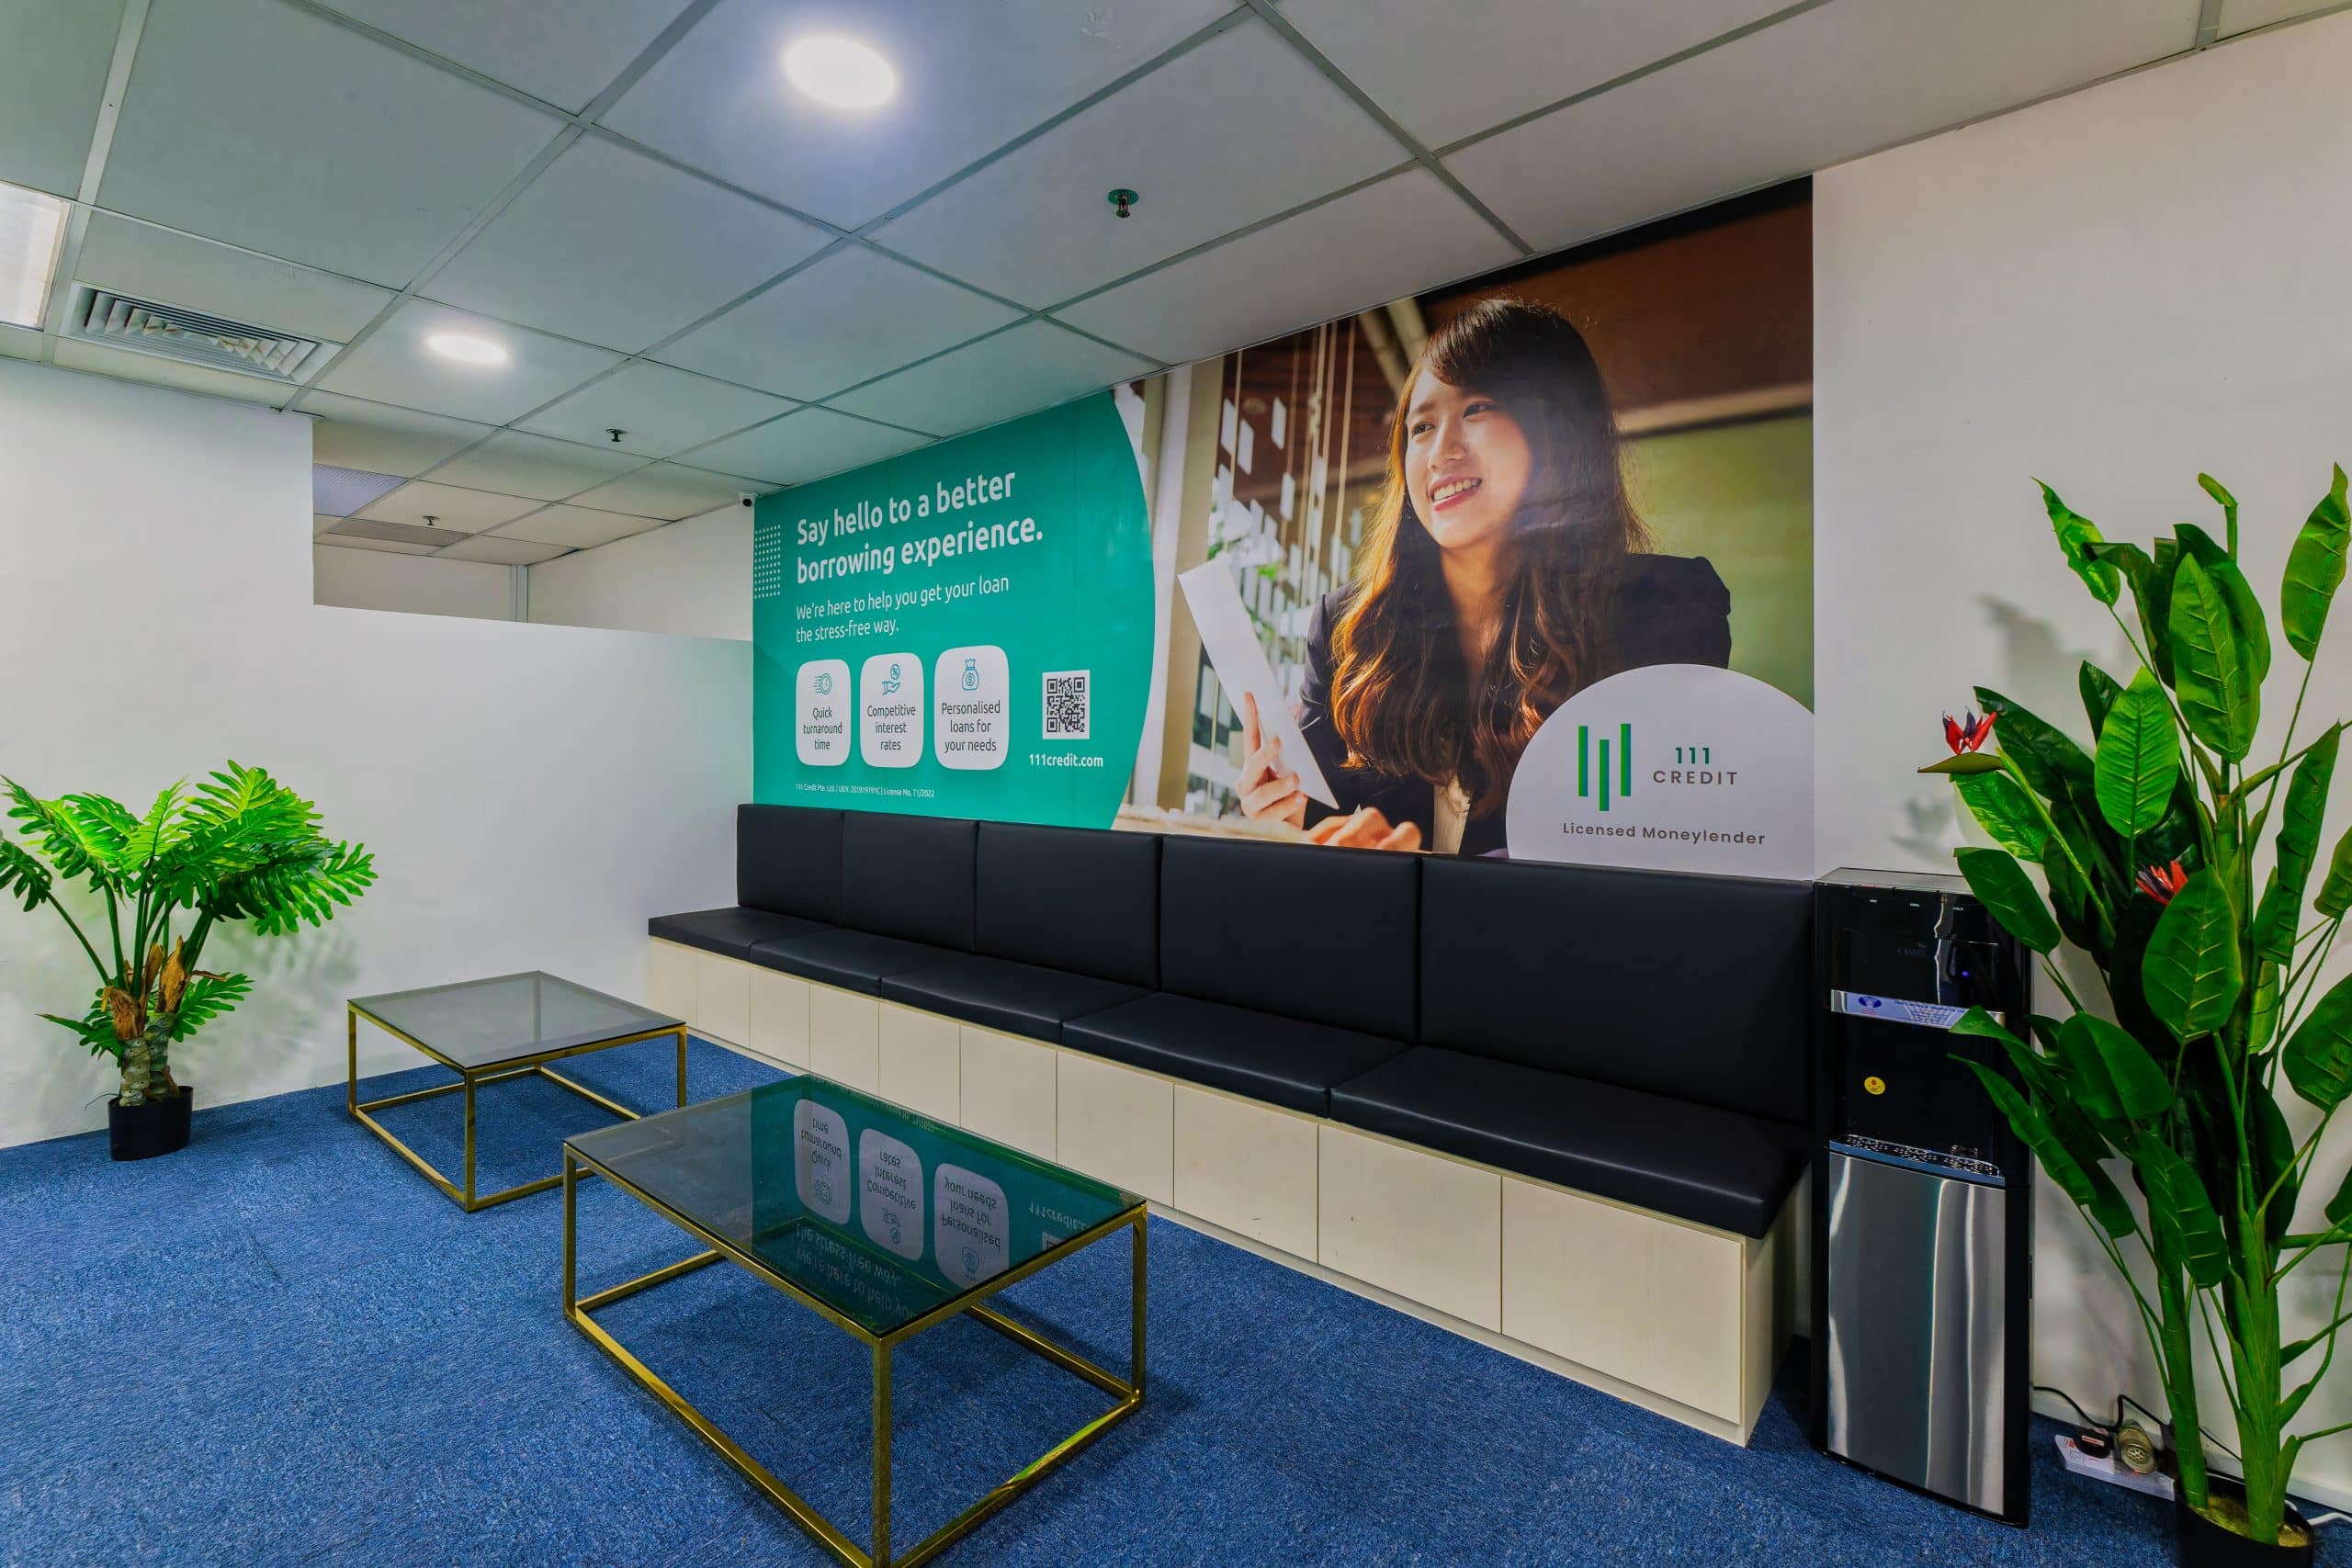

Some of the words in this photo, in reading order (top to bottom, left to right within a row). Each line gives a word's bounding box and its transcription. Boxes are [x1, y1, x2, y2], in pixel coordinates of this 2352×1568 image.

[797, 519, 828, 546] Say
[834, 502, 883, 536] hello
[888, 498, 910, 524] to
[918, 495, 929, 517] a
[936, 472, 1015, 514] better
[797, 543, 895, 584] borrowing
[901, 516, 1043, 567] experience.
[797, 602, 825, 621] We're
[827, 600, 851, 615] here
[854, 597, 865, 612] to
[867, 592, 892, 613] help
[896, 592, 917, 609] you
[920, 588, 942, 607] get
[945, 582, 975, 602] your
[979, 576, 1009, 595] loan
[797, 627, 812, 643] the
[815, 620, 871, 640] stress-free
[873, 618, 899, 637] way.
[812, 706, 832, 720] Quick
[867, 704, 916, 719] Competitive
[942, 701, 1001, 716] Personalised
[803, 721, 842, 734] turnaround
[876, 721, 907, 734] interest
[950, 719, 975, 733] loans
[977, 719, 991, 733] for
[814, 738, 830, 750] time
[880, 739, 900, 750] rates
[944, 739, 965, 753] your
[968, 739, 997, 752] needs
[1028, 752, 1103, 768] 111credit.com
[1675, 747, 1710, 764] 111
[1653, 770, 1738, 785] CREDIT
[1563, 822, 1635, 838] Licensed
[1643, 827, 1766, 845] Moneylender
